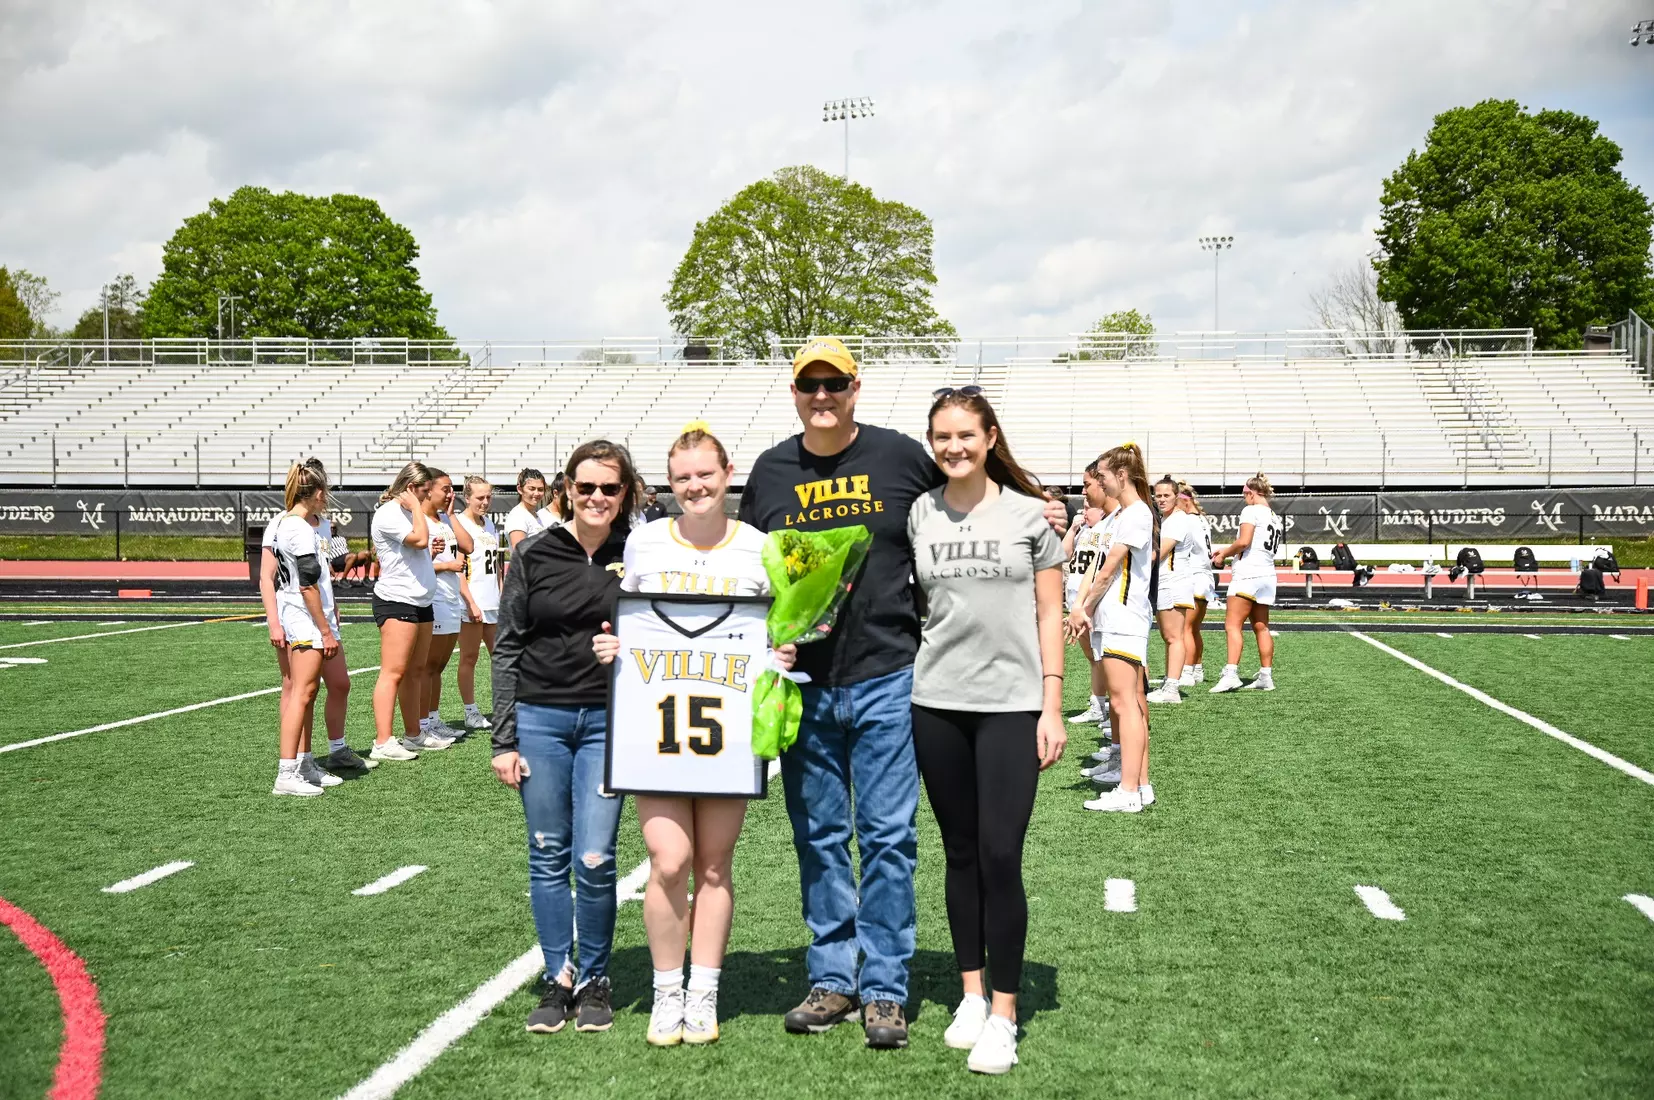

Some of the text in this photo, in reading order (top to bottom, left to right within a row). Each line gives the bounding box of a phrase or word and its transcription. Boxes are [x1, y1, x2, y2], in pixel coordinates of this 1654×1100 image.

[795, 475, 871, 508] VILLE
[128, 505, 235, 524] MARAUDERS
[785, 501, 884, 525] LACROSSE
[1382, 508, 1506, 527] MARAUDERS
[928, 540, 1001, 565] VILLE
[659, 571, 739, 596] VILLE
[920, 566, 1013, 582] LACROSSE
[630, 648, 750, 693] VILLE
[656, 693, 724, 757] 15
